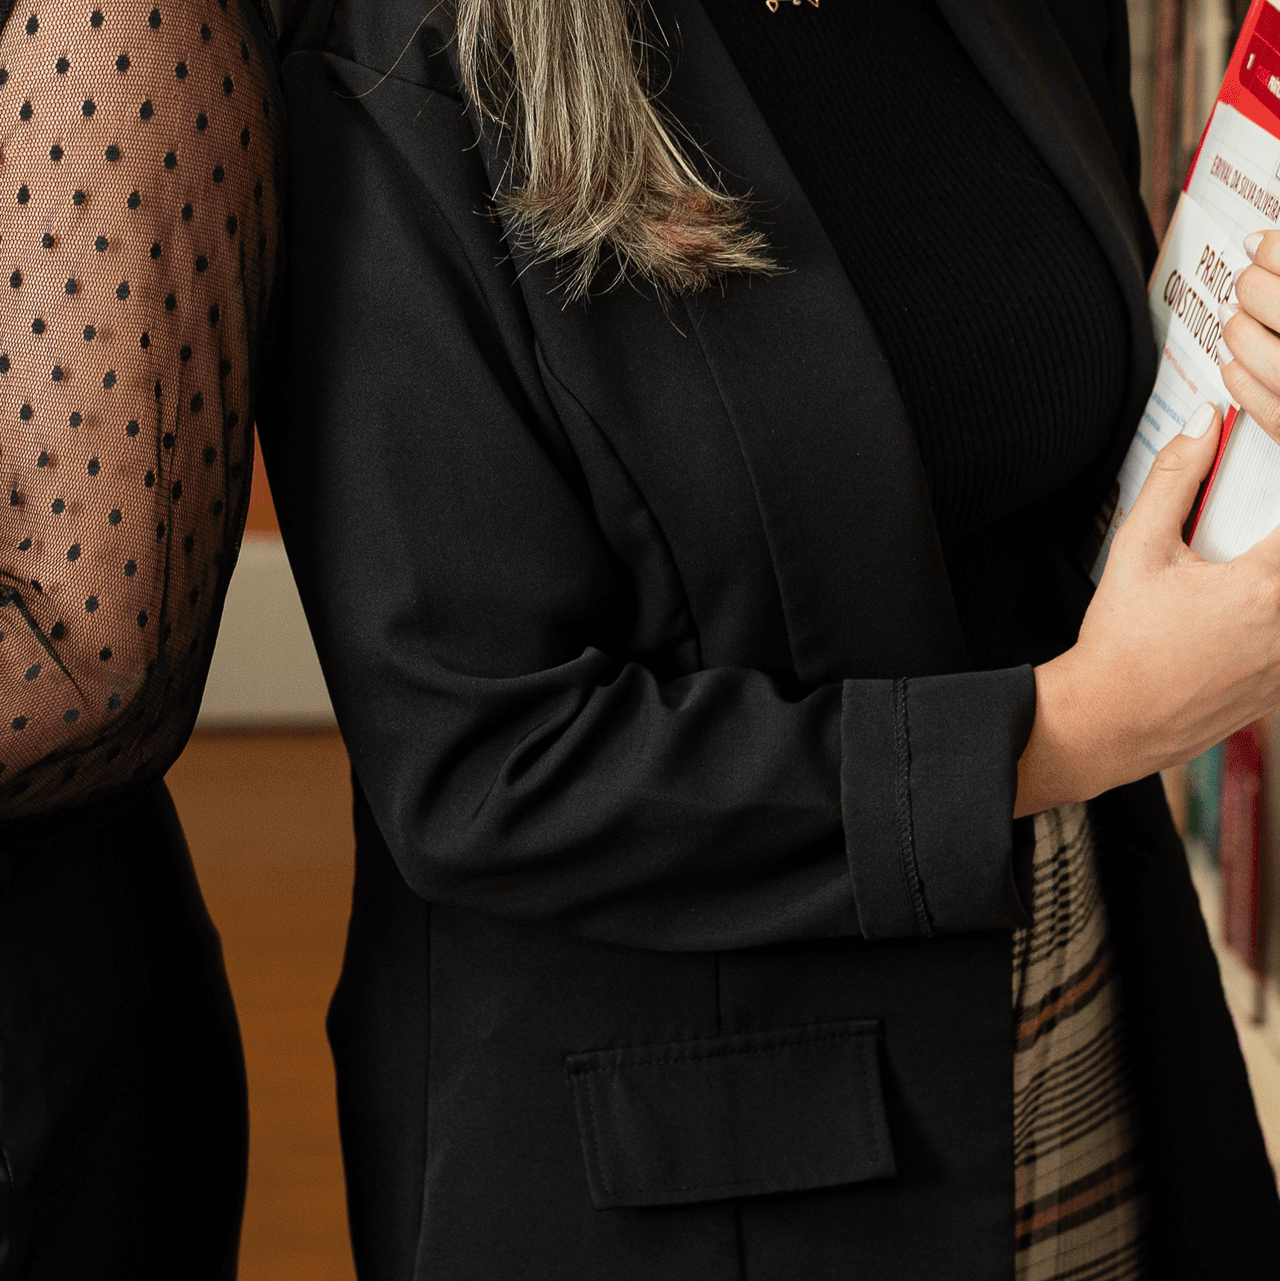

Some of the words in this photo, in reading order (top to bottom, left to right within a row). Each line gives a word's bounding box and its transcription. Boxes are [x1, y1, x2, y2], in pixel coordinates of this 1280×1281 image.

[1229, 169, 1242, 193] DA
[1237, 175, 1259, 208] SILVA
[1194, 244, 1234, 305] PRÁTICA
